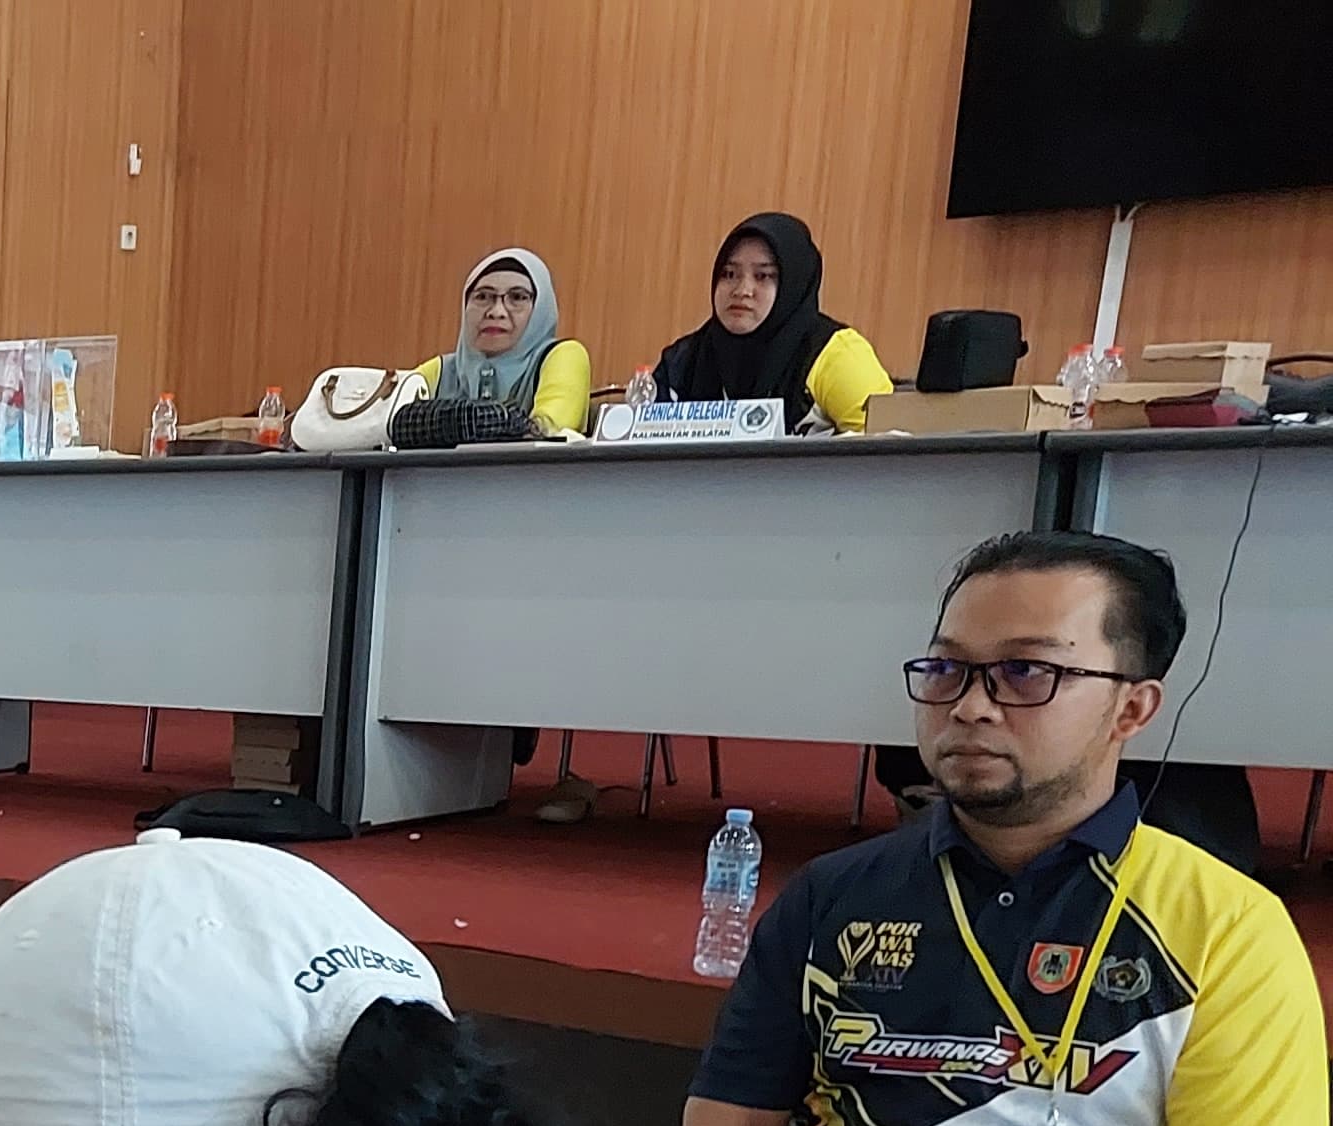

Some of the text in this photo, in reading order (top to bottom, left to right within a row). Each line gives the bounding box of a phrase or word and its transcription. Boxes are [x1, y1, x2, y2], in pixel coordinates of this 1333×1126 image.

[686, 400, 737, 420] DELEGATE
[875, 921, 923, 937] POR
[879, 935, 913, 952] WA
[870, 950, 916, 968] NAS
[294, 944, 422, 993] CONVERSE
